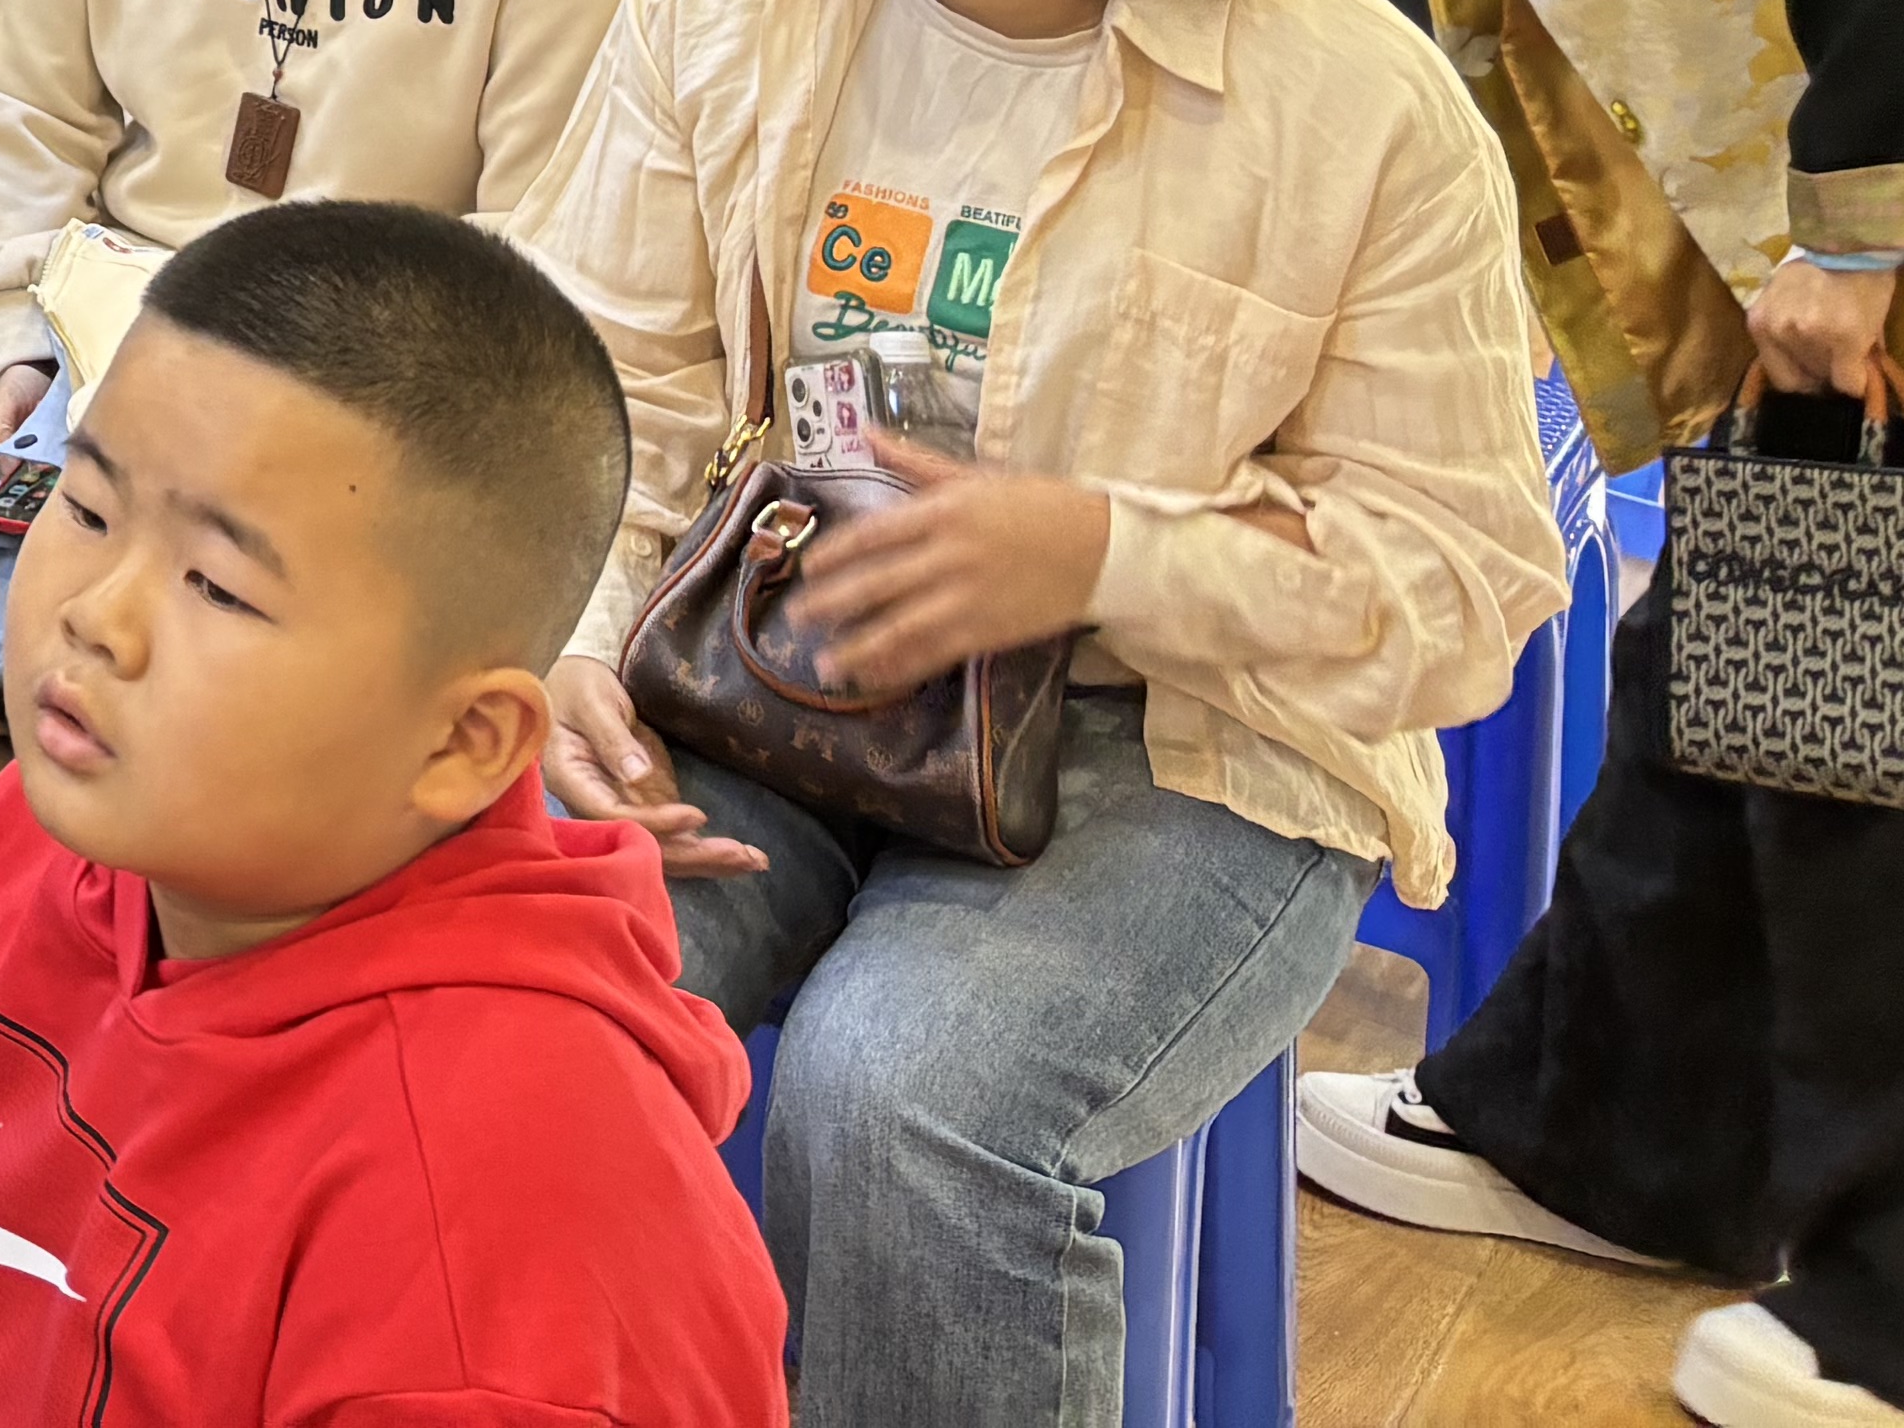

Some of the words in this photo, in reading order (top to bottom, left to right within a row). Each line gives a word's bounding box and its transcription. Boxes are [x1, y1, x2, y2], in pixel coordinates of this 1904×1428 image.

[257, 17, 319, 50] PERSON
[842, 179, 931, 211] FASHIONS
[822, 223, 892, 282] Ce
